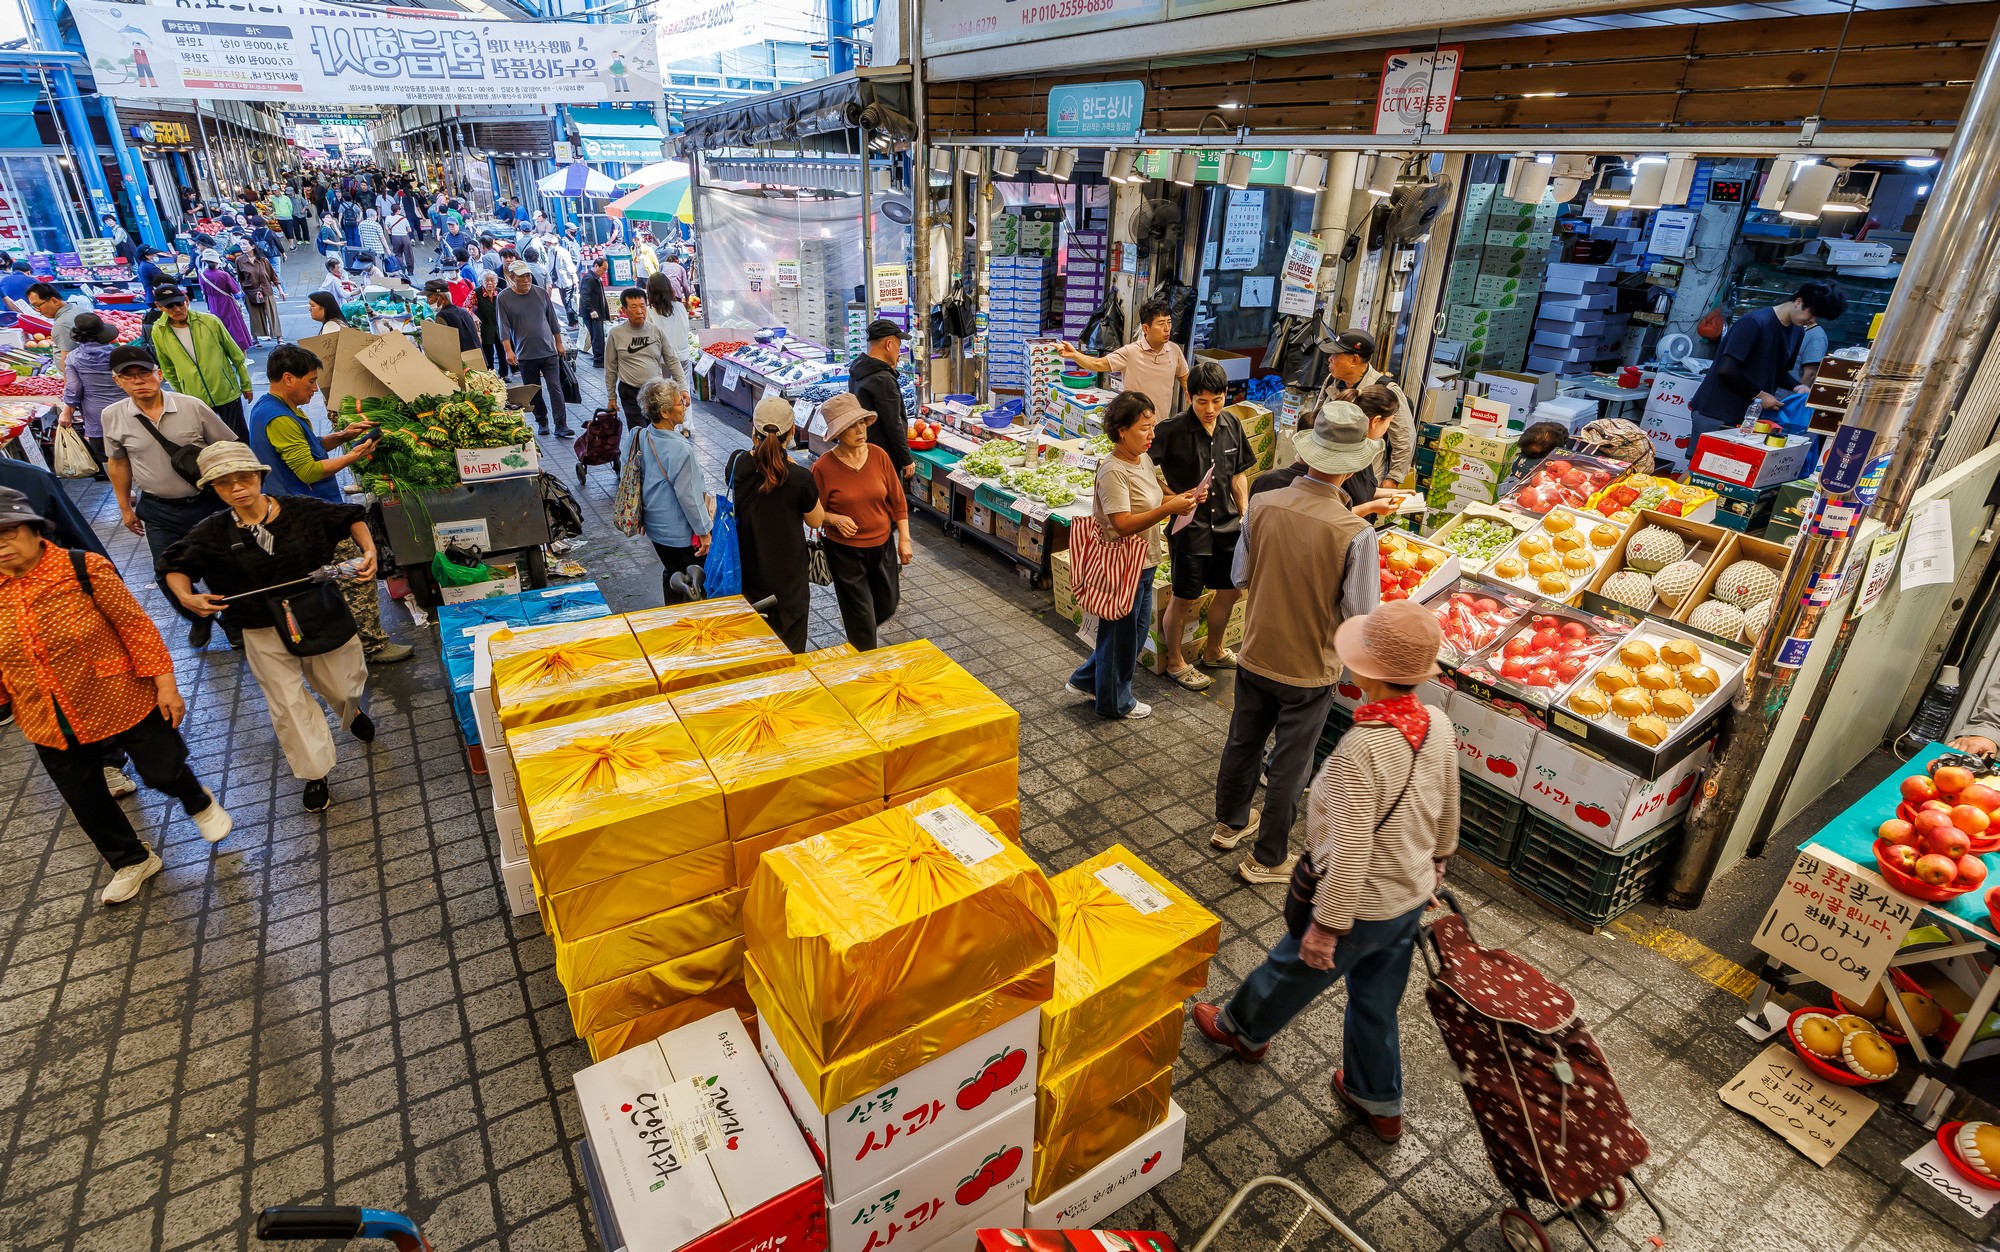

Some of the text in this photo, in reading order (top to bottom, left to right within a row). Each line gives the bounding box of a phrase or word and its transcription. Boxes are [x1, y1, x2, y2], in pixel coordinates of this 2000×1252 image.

[1083, 95, 1134, 120] 한도상사
[1382, 95, 1447, 113] CCTV 작동중
[1082, 122, 1101, 132] 합리적인
[1101, 122, 1115, 132] 가격의
[1244, 192, 1250, 202] 9
[1290, 248, 1318, 266] 환급행사
[1287, 260, 1314, 278] 참여점포
[878, 278, 903, 289] 환급행사
[879, 287, 904, 298] 참여점포
[630, 336, 651, 347] NIKE
[1655, 392, 1685, 405] 사과
[1471, 410, 1497, 422] Supreme
[471, 461, 503, 474] 시금치
[1469, 683, 1492, 699] 사과
[1454, 738, 1483, 759] 사과
[1535, 763, 1557, 781] 산골
[1532, 780, 1571, 806] 사과
[1630, 792, 1665, 822] 사과
[1795, 856, 1913, 924] 햇 홍로 꿀사과
[1804, 903, 1871, 950] 한바구니
[1009, 1081, 1030, 1097] 15 kg
[846, 1086, 900, 1124] 산골
[1761, 1073, 1837, 1129] 한바구니
[631, 1091, 684, 1181] 단양사과
[855, 1099, 948, 1162] 사과
[1006, 1180, 1016, 1191] 15
[851, 1188, 901, 1225] 산골
[861, 1197, 946, 1252] 사과
